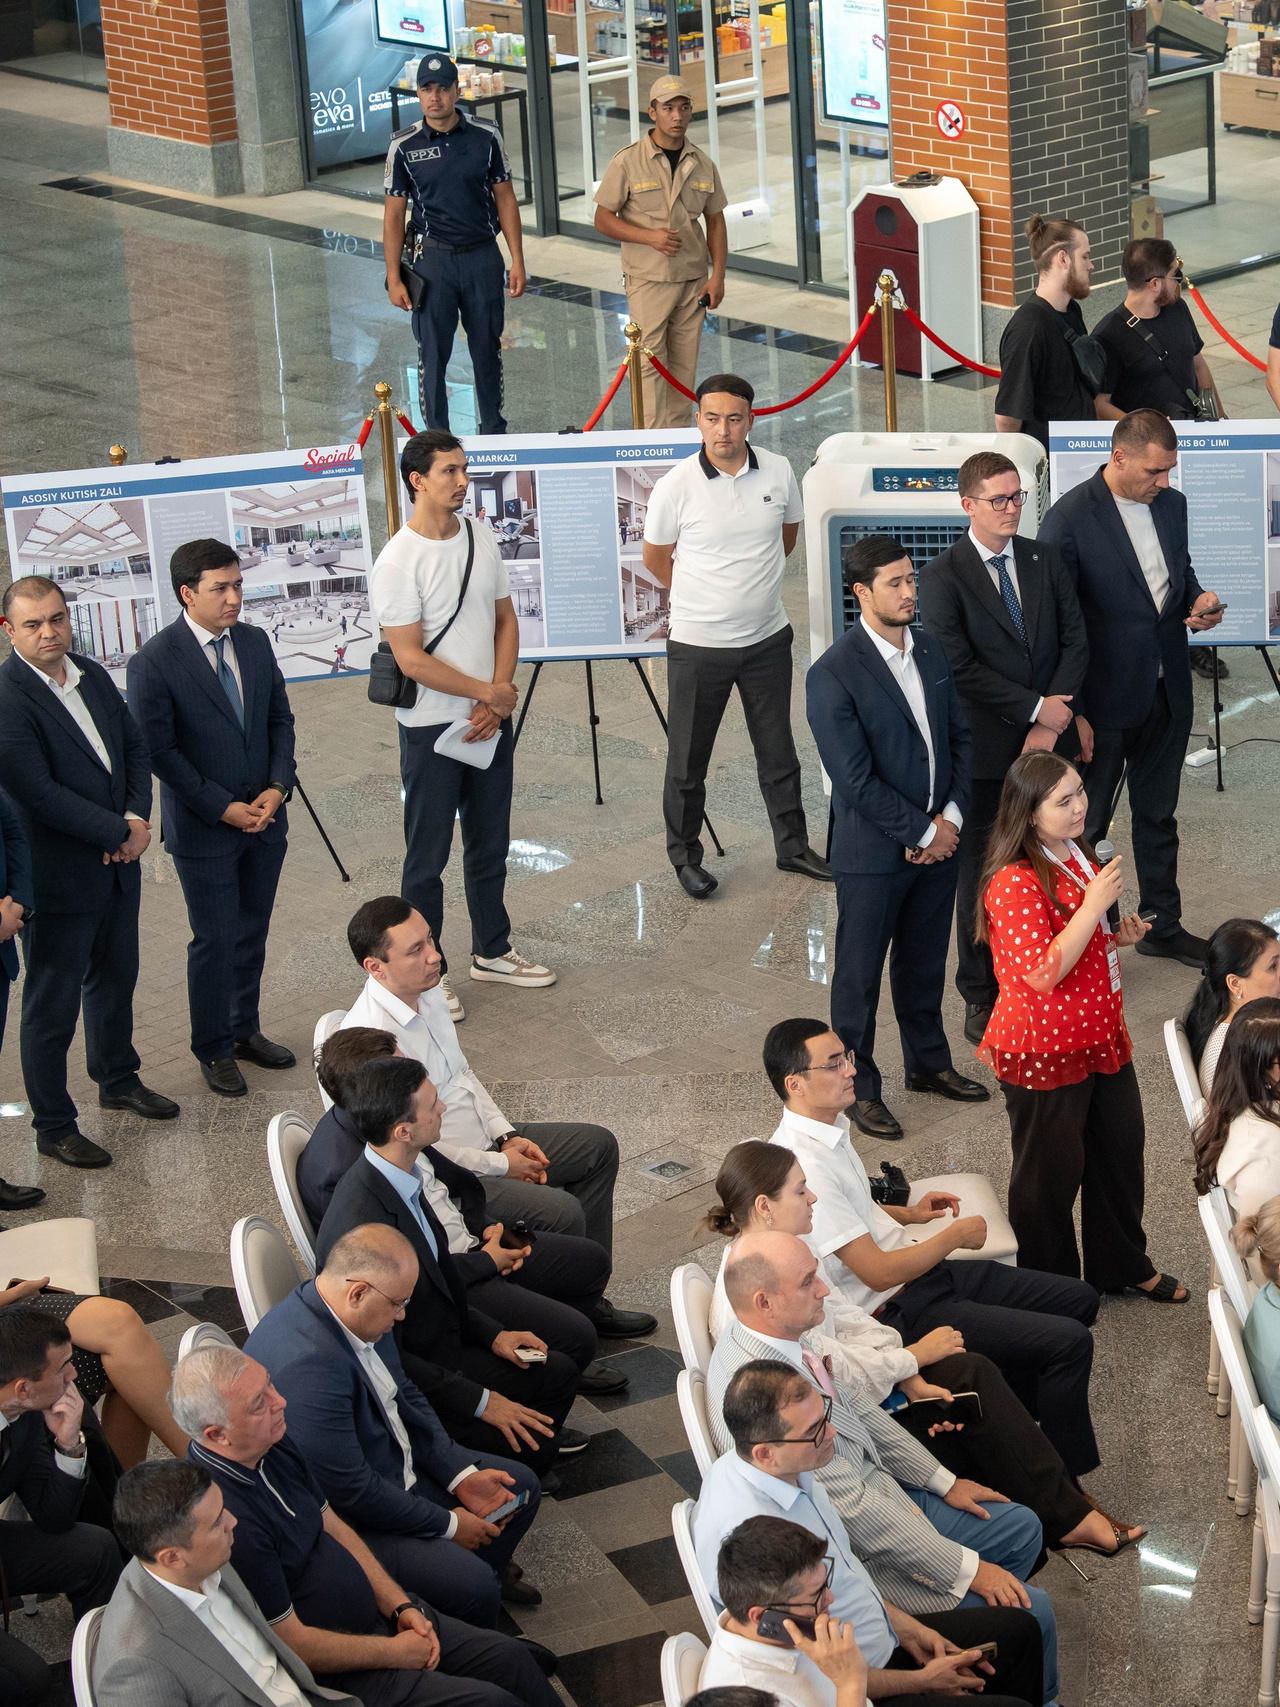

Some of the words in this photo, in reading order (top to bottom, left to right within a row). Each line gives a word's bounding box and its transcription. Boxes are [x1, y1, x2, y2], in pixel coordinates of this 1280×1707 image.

[310, 87, 346, 110] evo
[411, 149, 437, 160] PPX
[1068, 440, 1107, 449] QABULNI
[303, 444, 355, 473] Social
[476, 453, 517, 463] MARKAZI
[616, 449, 642, 458] FOOD
[643, 448, 674, 457] COURT
[21, 492, 58, 504] ASOSIY
[60, 488, 98, 500] KUTISH
[100, 487, 122, 497] ZALI
